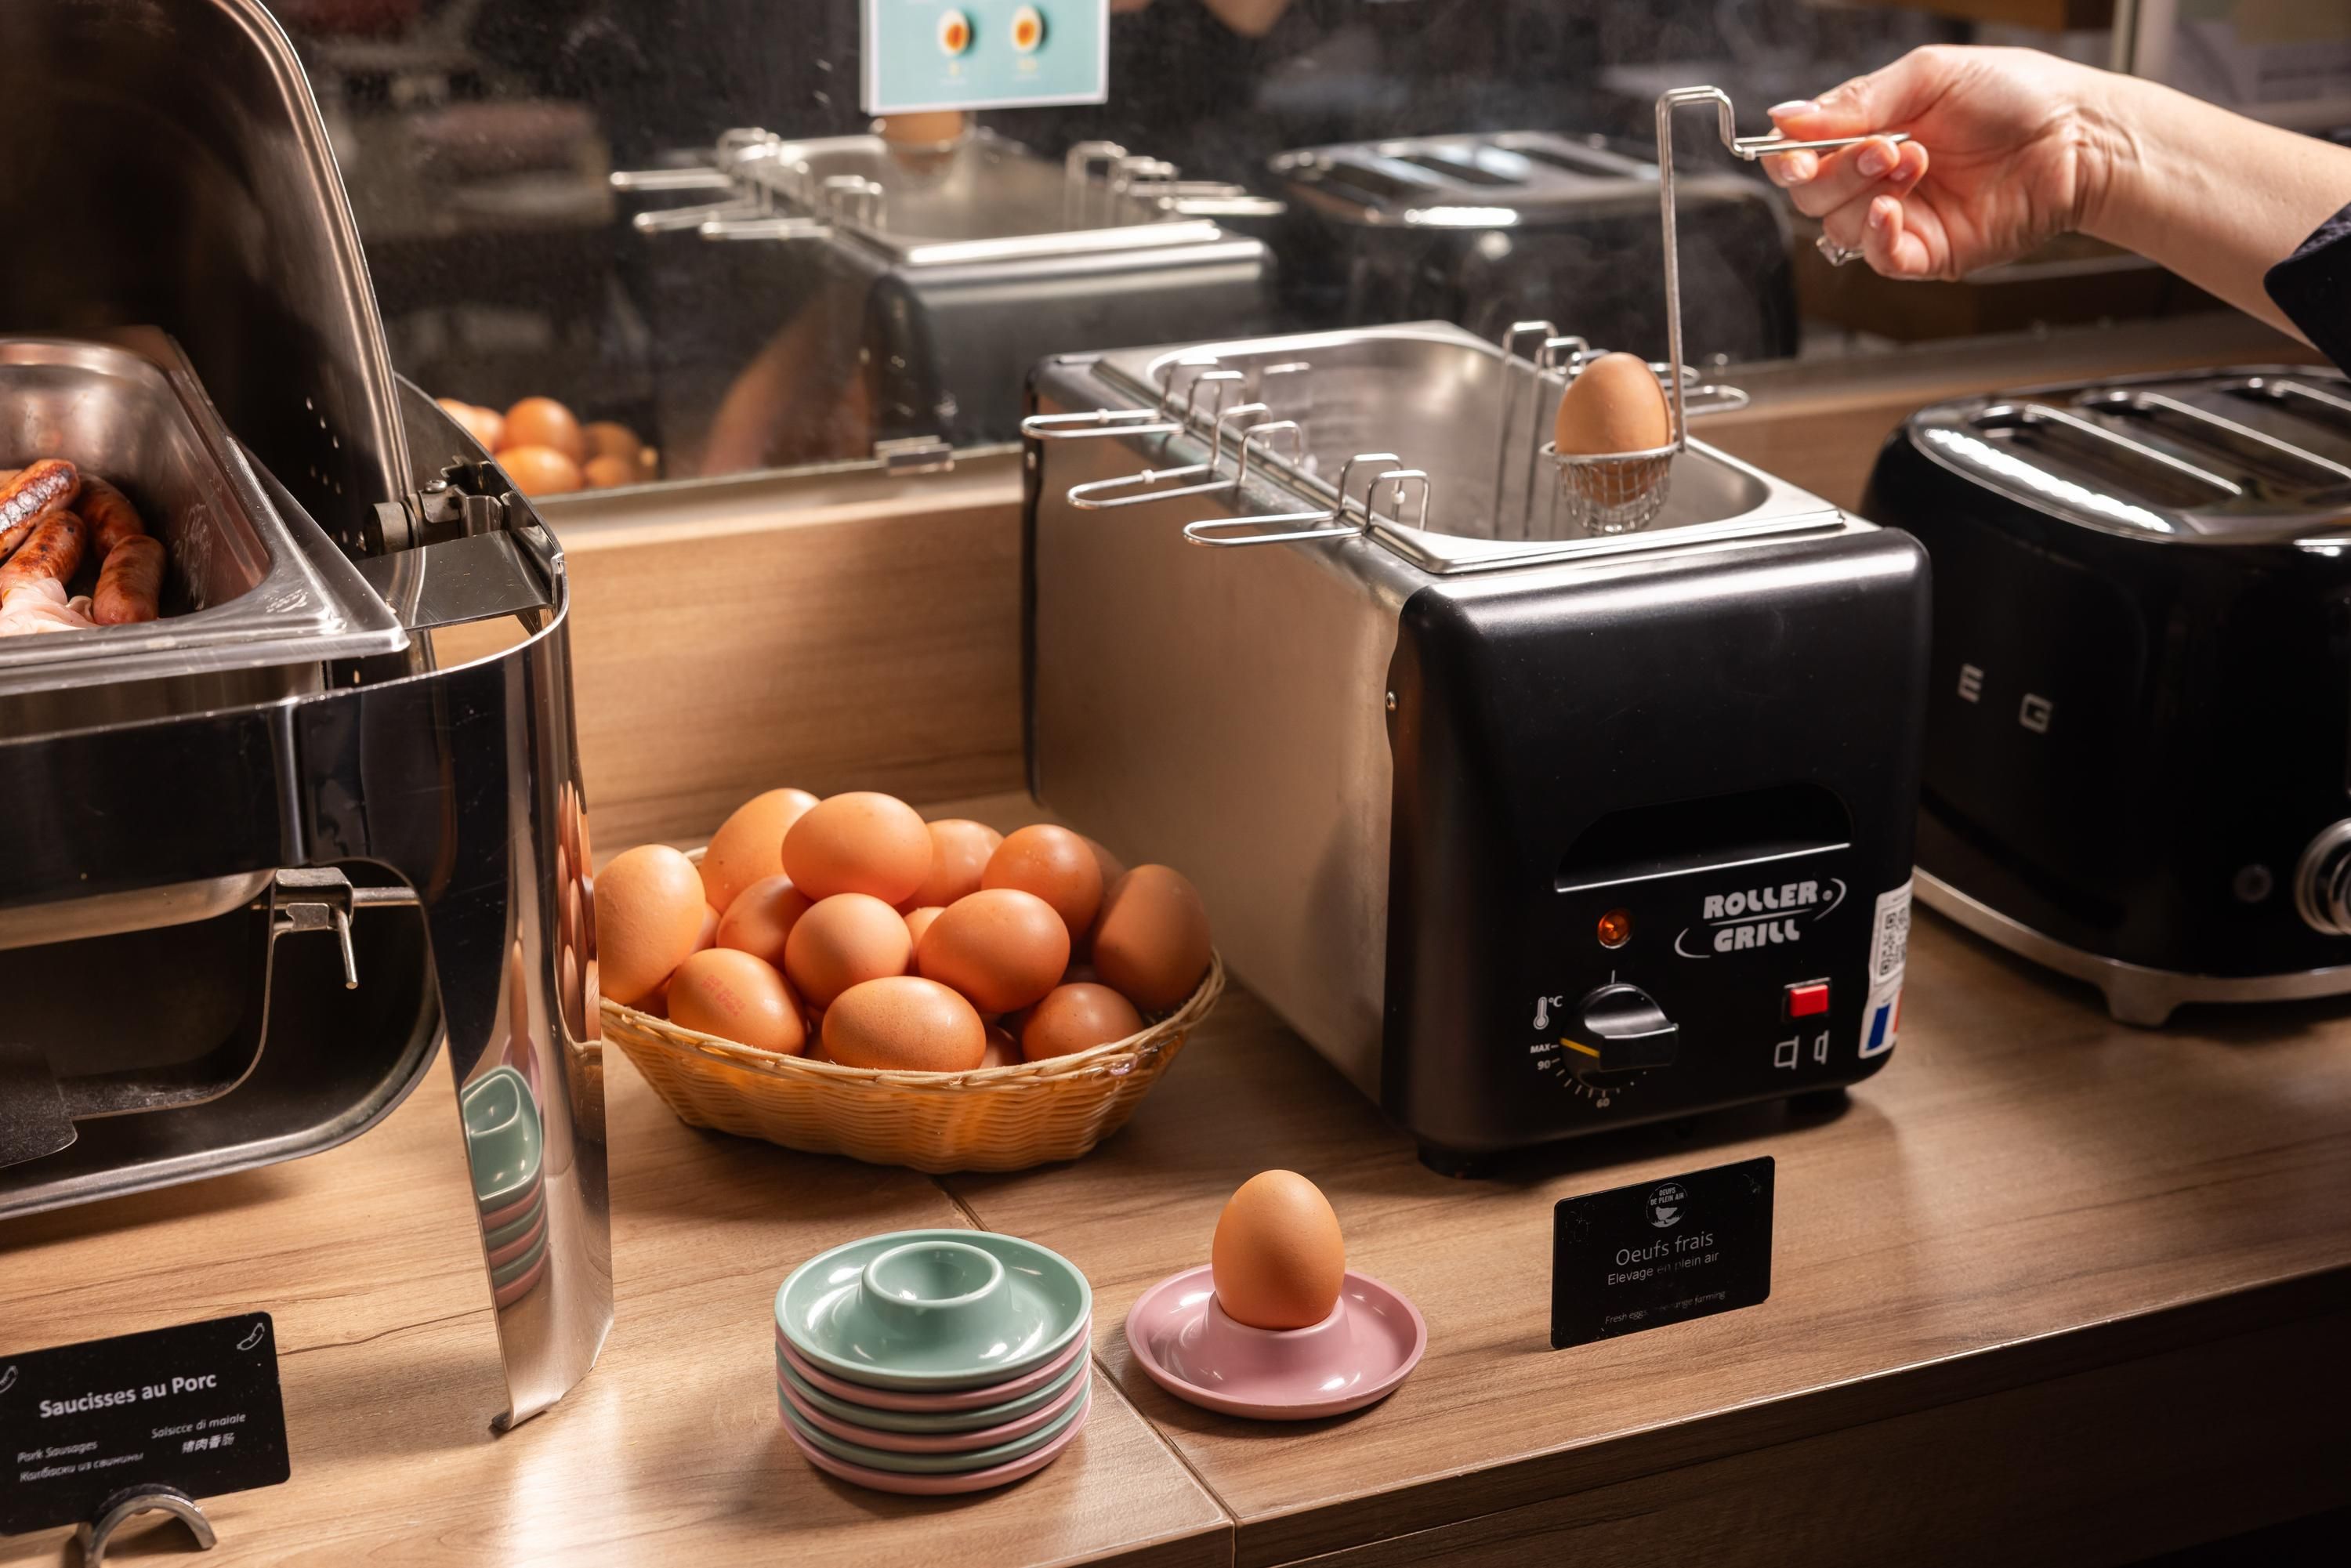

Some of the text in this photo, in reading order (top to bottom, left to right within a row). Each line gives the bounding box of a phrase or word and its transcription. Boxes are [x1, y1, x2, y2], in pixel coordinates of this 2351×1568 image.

[1958, 663, 2053, 734] EG
[1703, 880, 1819, 920] ROLLER
[1714, 918, 1800, 953] GRILL
[1530, 1043, 1551, 1054] MAX
[1537, 1059, 1551, 1070] 90
[1596, 1097, 1610, 1109] 60
[1650, 1192, 1685, 1206] DE PLEIN AIR
[1659, 1186, 1676, 1197] OEUFS
[1616, 1230, 1714, 1266] Oeufs frais
[1607, 1267, 1654, 1285] Elevage
[1704, 1251, 1719, 1264] air
[1605, 1312, 1628, 1324] Fresh
[1694, 1291, 1726, 1305] farming
[39, 1374, 217, 1418] Saucisses au Porc
[151, 1414, 246, 1439] Salsicce di maiale
[17, 1440, 98, 1463] Pork Sausages
